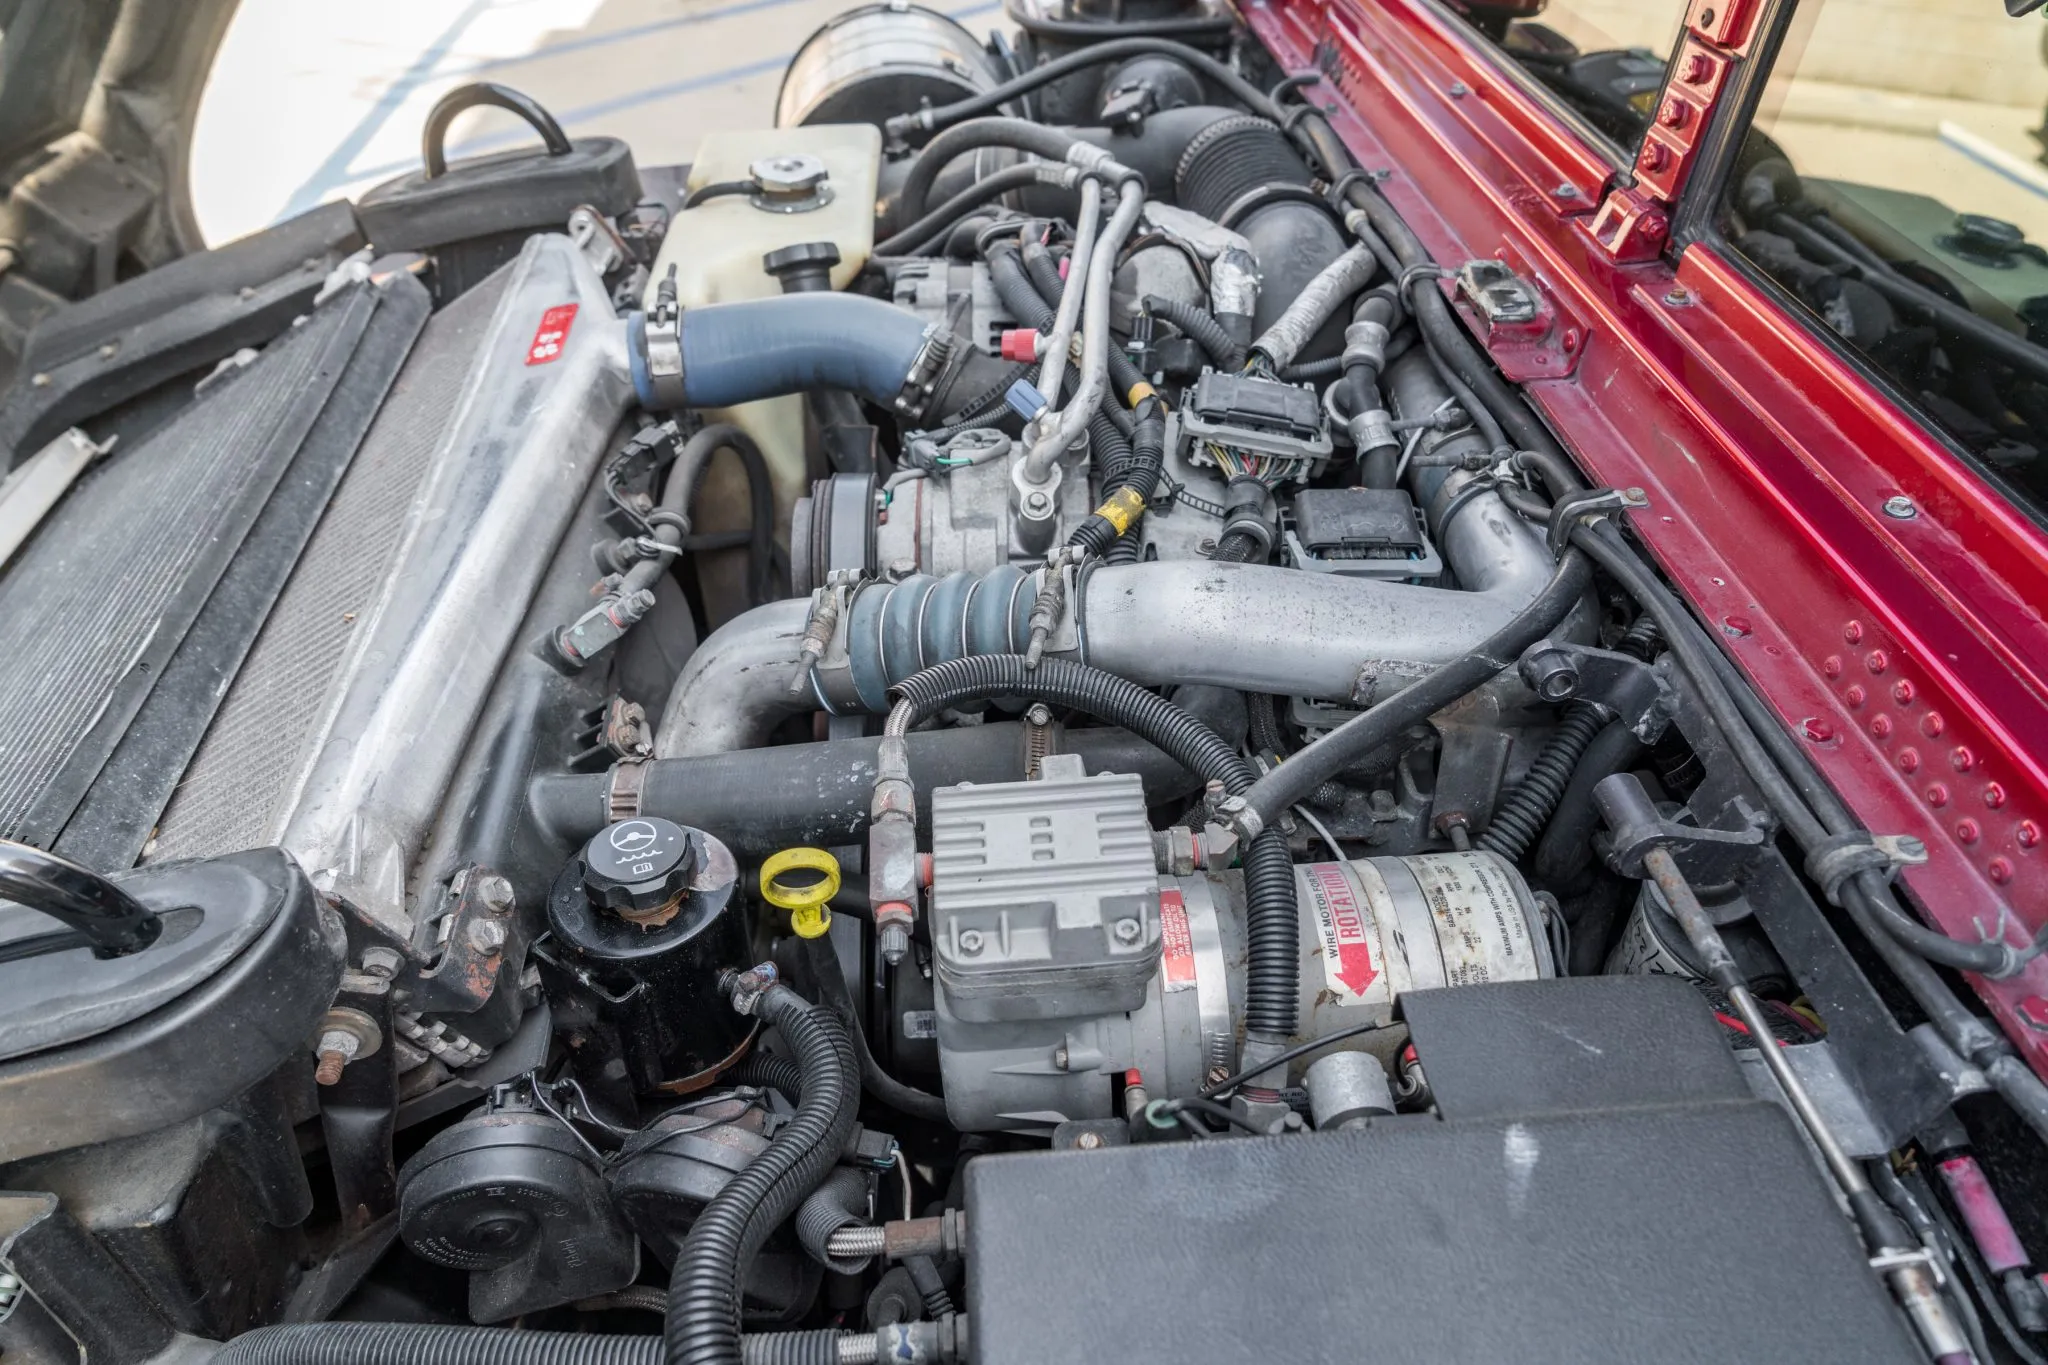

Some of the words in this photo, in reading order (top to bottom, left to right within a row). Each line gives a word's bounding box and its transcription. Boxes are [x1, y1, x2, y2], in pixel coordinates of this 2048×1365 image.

[1310, 878, 1321, 892] FOR
[1474, 869, 1495, 898] COMPRESSOR
[1315, 893, 1332, 928] MOTOR
[1319, 871, 1361, 939] ROTATION
[1488, 897, 1500, 910] WITH
[1495, 911, 1505, 927] AMPS
[1178, 946, 1185, 957] OR
[1324, 930, 1338, 959] WIRE
[1500, 927, 1513, 957] MAXIMUM
[1172, 949, 1180, 960] DO
